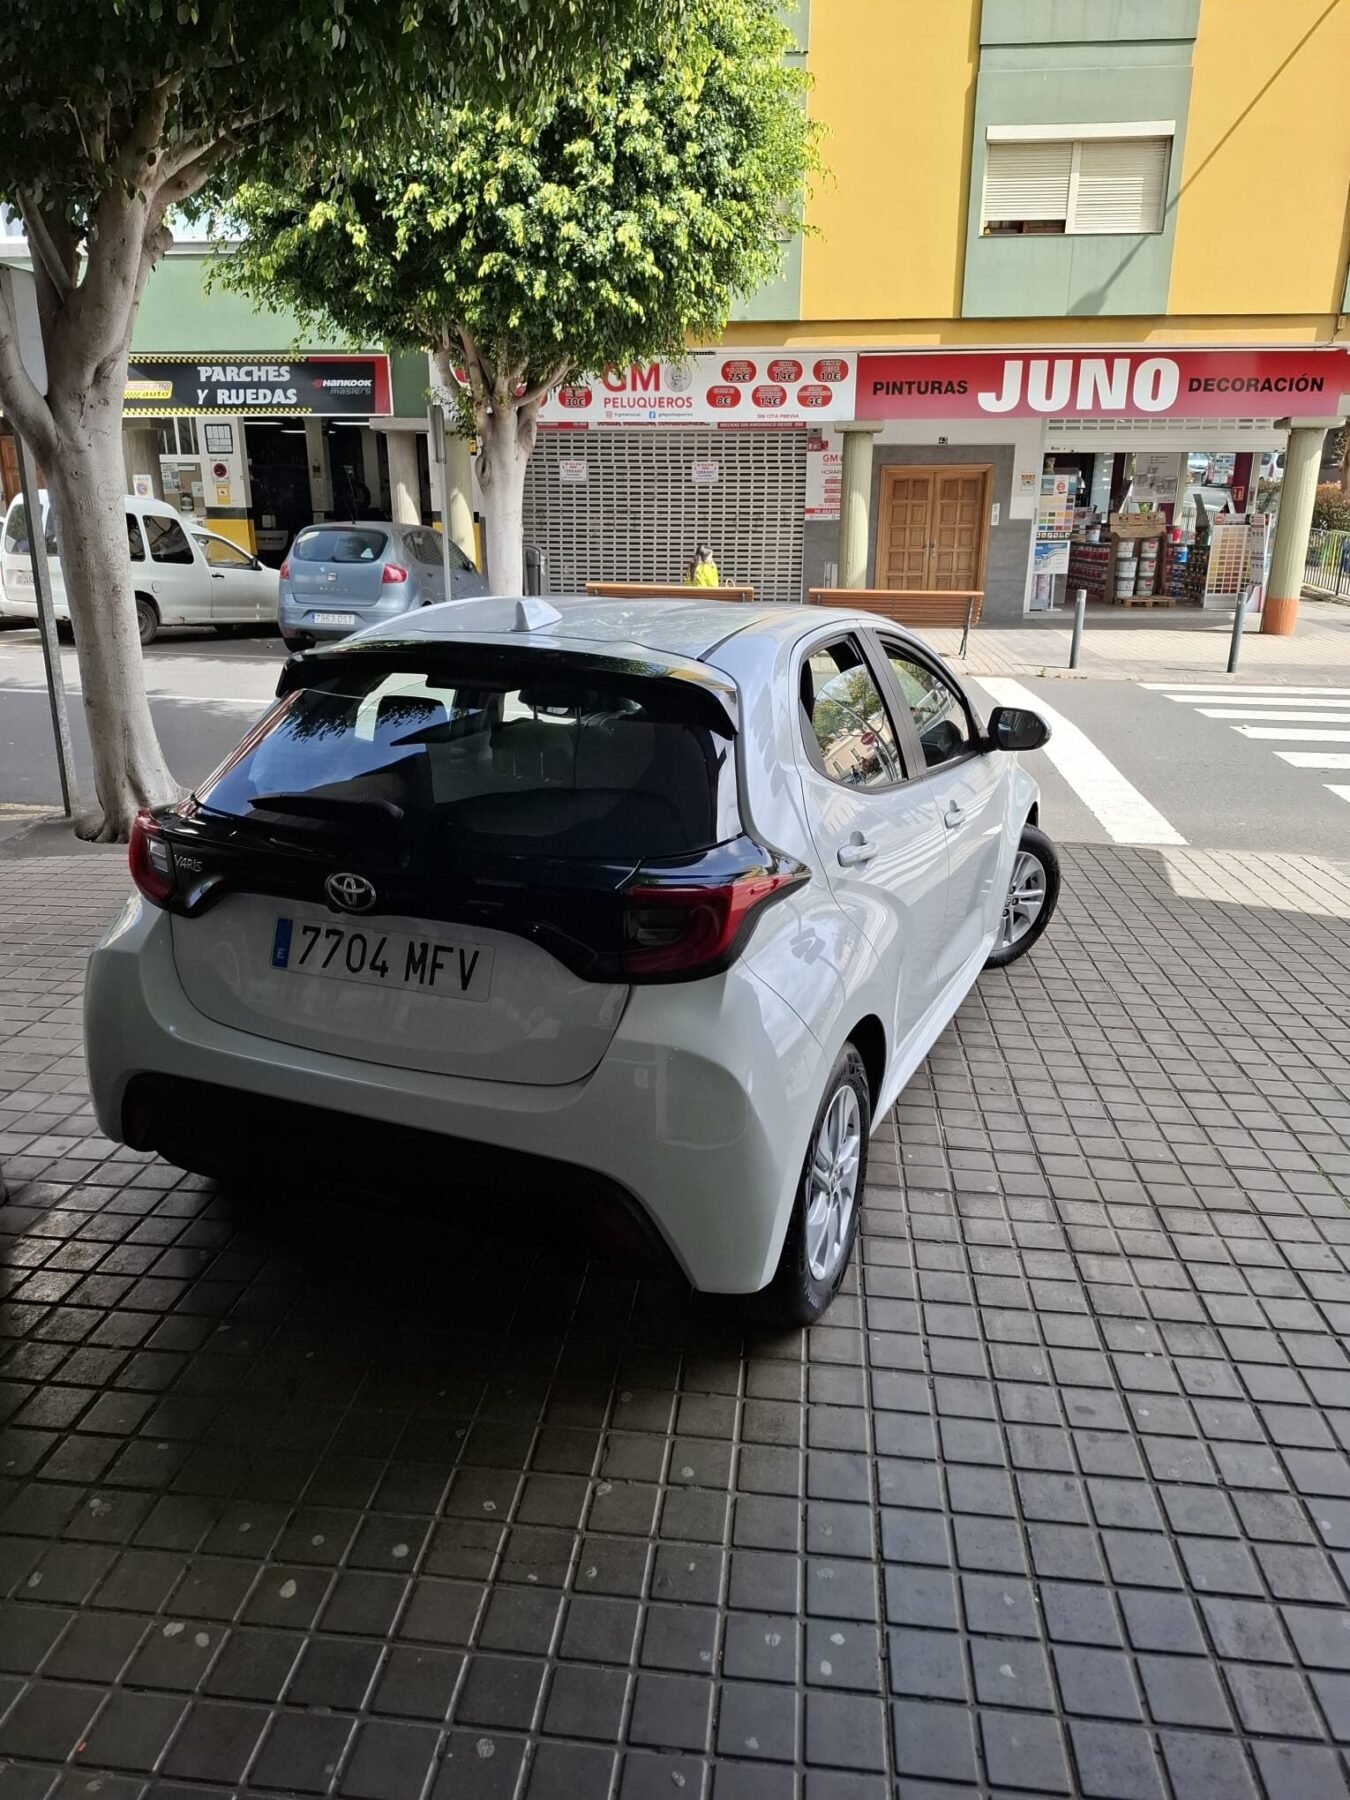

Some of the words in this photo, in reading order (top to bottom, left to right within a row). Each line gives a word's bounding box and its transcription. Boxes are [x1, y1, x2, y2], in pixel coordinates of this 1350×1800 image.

[197, 366, 291, 382] PARCHES
[602, 361, 660, 392] GM
[728, 373, 749, 382] 25€
[775, 372, 795, 381] 14€
[821, 372, 841, 381] 10€
[872, 380, 969, 396] PINTURAS
[977, 357, 1180, 413] JUNO
[1188, 373, 1325, 393] DECORACIÓN
[197, 389, 209, 405] Y
[216, 389, 298, 405] RUEDAS
[566, 398, 585, 407] 30€
[603, 396, 693, 409] PELUQUEROS
[716, 396, 732, 406] 8€
[760, 396, 781, 406] 14€
[808, 396, 823, 406] 4€
[823, 454, 839, 463] GM
[173, 854, 203, 872] YARIS
[298, 925, 389, 978] 7704
[404, 940, 480, 991] MFV
